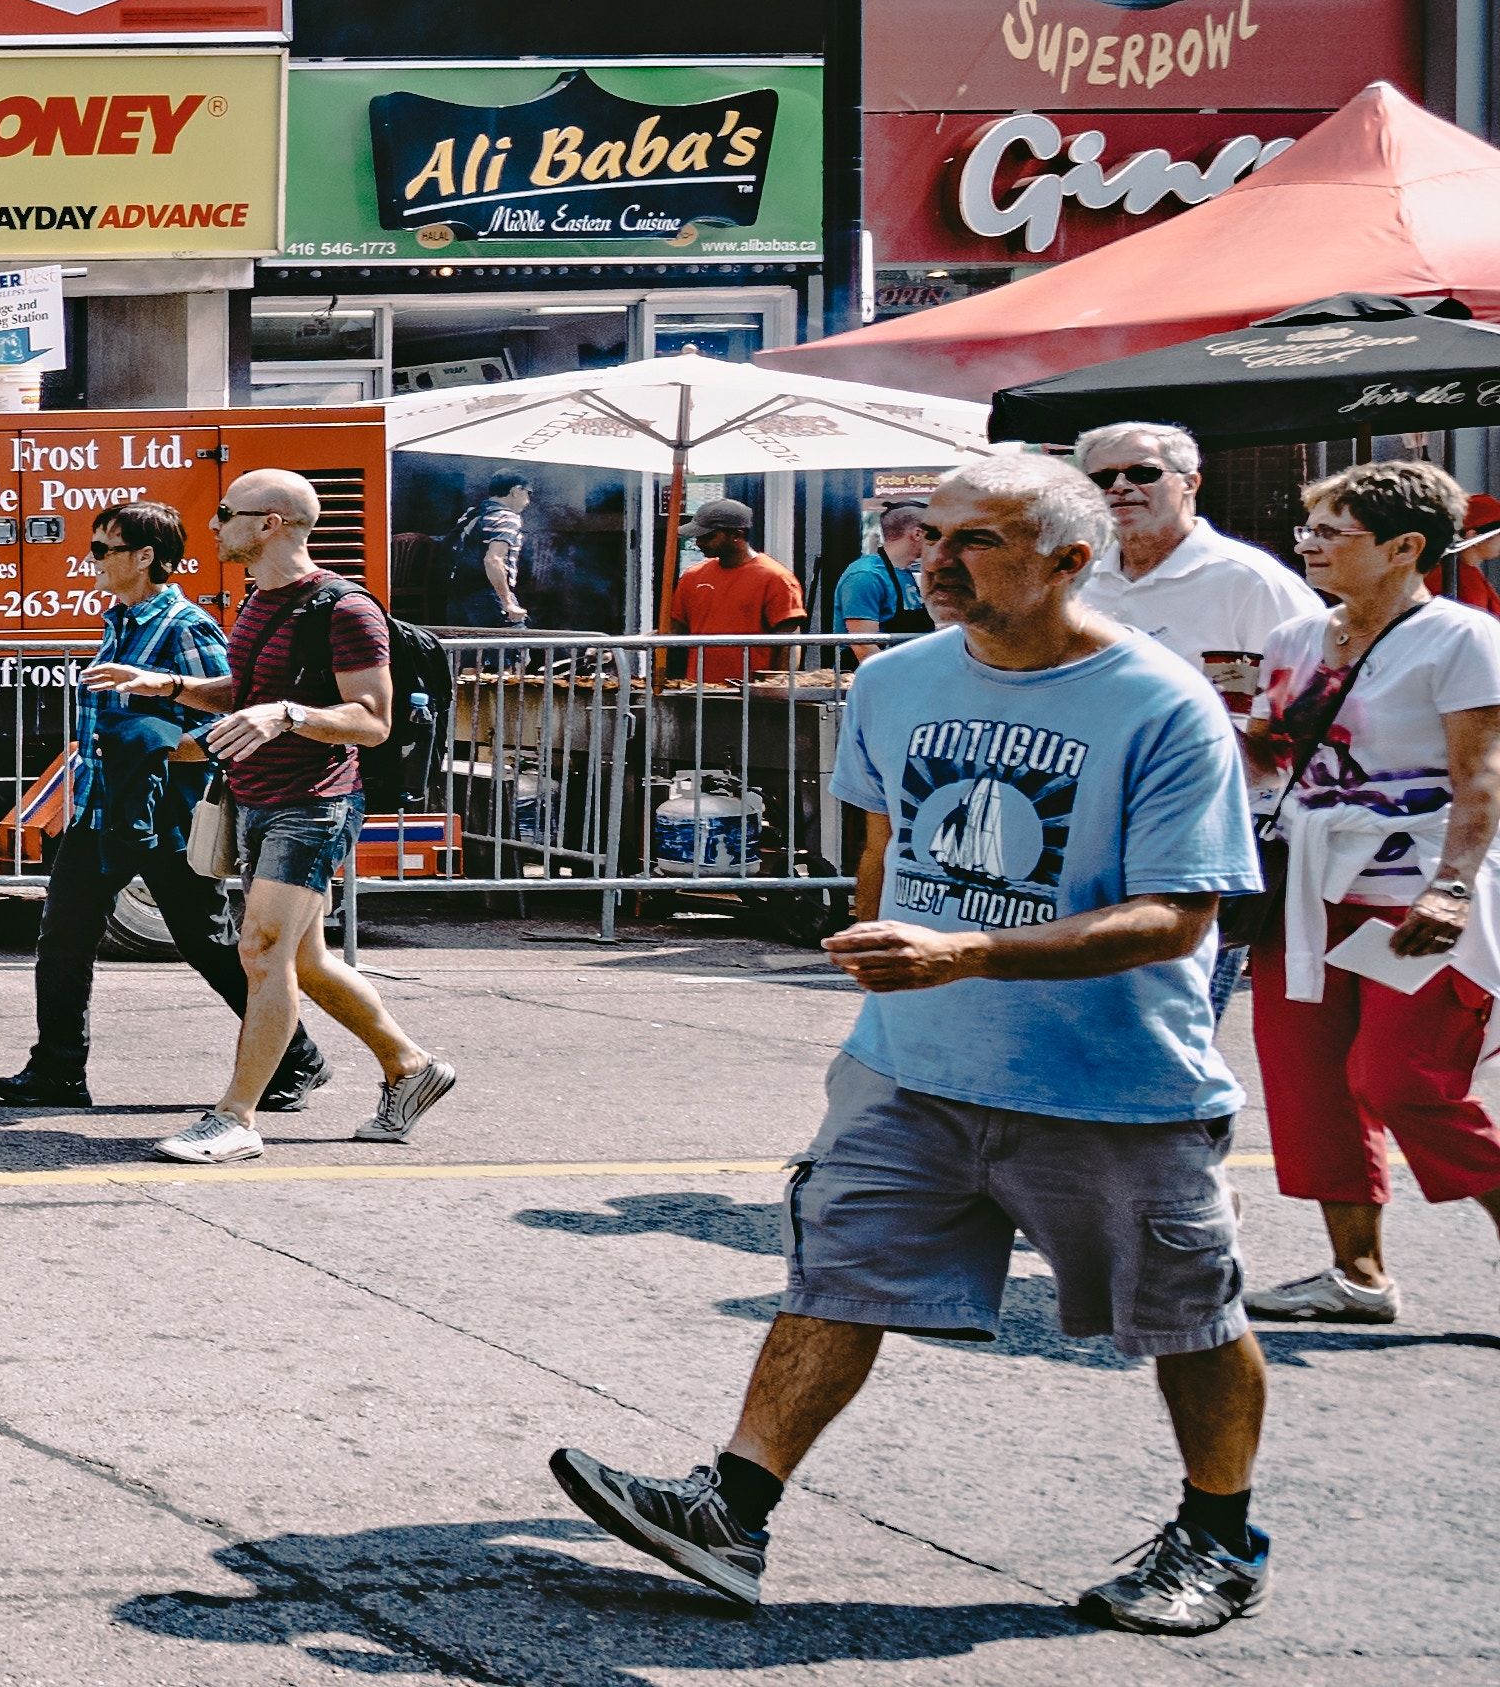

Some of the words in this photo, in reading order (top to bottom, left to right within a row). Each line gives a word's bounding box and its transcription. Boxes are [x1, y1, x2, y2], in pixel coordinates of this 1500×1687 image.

[405, 134, 512, 200] Ali
[530, 110, 762, 187] Baba's
[99, 203, 249, 229] ADVANCE
[477, 206, 546, 237] Middle
[550, 204, 611, 233] Eastern
[619, 204, 681, 232] Cuisine
[421, 230, 451, 242] HALAL
[701, 239, 817, 253] www.alibabas.ca
[286, 243, 315, 255] 416
[320, 242, 396, 255] 546-1773
[17, 299, 37, 311] and
[11, 311, 49, 325] Station
[1415, 381, 1466, 404] the
[10, 438, 99, 473] Frost
[119, 435, 193, 470] Ltd.
[40, 480, 147, 510] Power
[907, 719, 1090, 778] ANTIGUA
